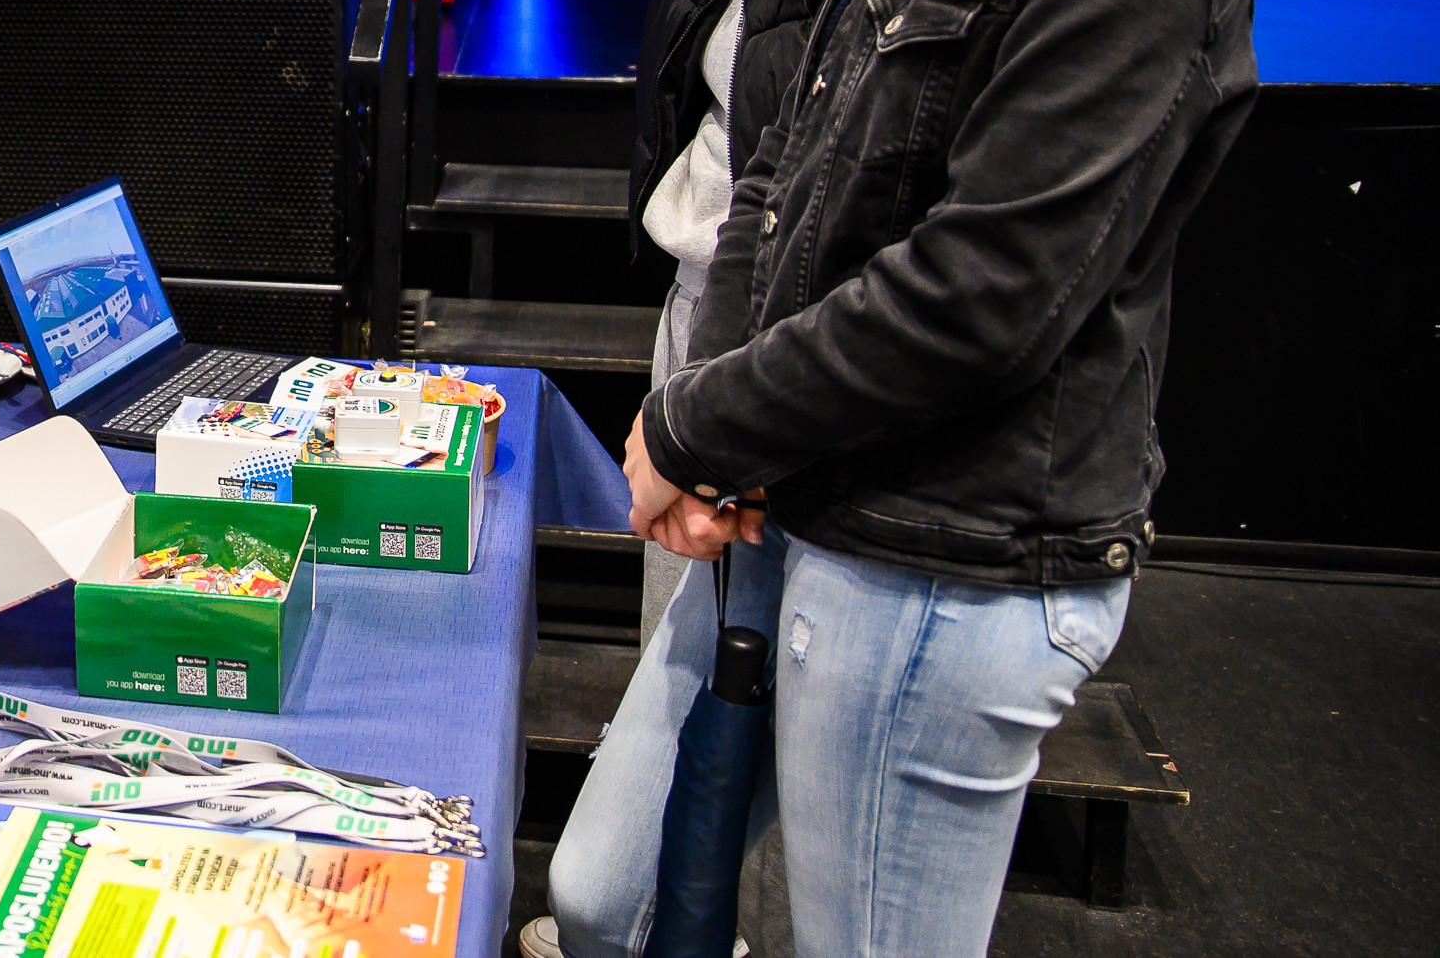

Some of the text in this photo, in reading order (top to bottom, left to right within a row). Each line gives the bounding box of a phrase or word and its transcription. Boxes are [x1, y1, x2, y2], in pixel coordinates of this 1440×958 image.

[287, 379, 314, 402] ino
[341, 537, 369, 545] download
[343, 546, 369, 555] here:
[132, 671, 165, 681] download
[106, 680, 119, 688] you
[135, 681, 165, 692] here:
[188, 737, 236, 756] ino
[91, 782, 141, 801] ino
[336, 815, 388, 834] ino
